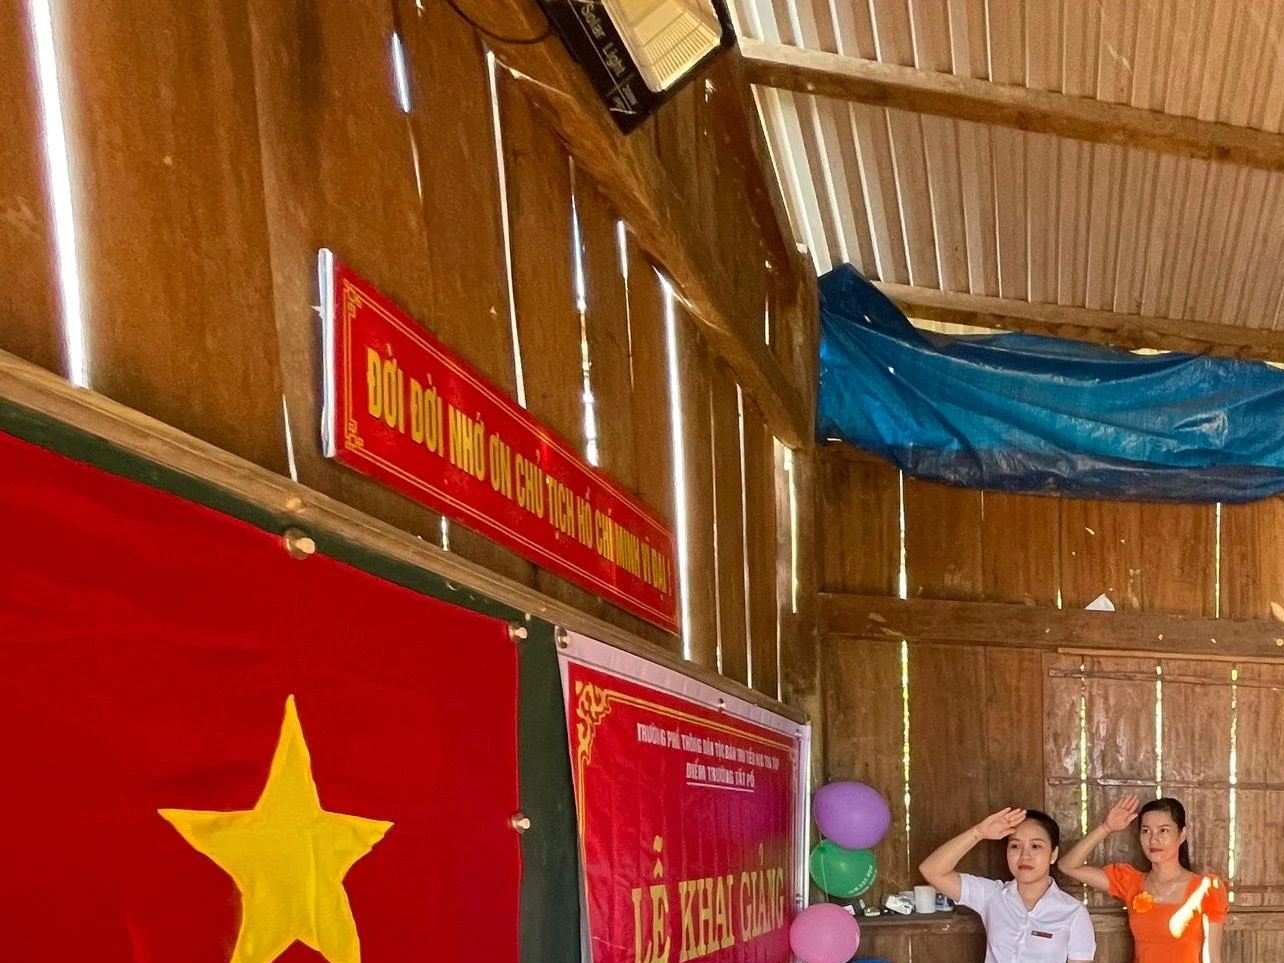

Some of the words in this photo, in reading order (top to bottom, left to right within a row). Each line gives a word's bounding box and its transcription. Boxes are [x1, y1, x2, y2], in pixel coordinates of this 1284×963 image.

[581, 2, 606, 39] Solar
[602, 42, 626, 77] Light
[366, 343, 405, 434] ĐỜI
[410, 373, 444, 458] ĐỜI
[448, 403, 485, 482] NHỚ
[489, 432, 512, 500] ƠN
[515, 449, 545, 519] CHỦ
[546, 475, 575, 540] TỊCH
[595, 508, 614, 562] CHÍ
[678, 873, 735, 963] KHAI
[740, 843, 784, 942] GIẢNG
